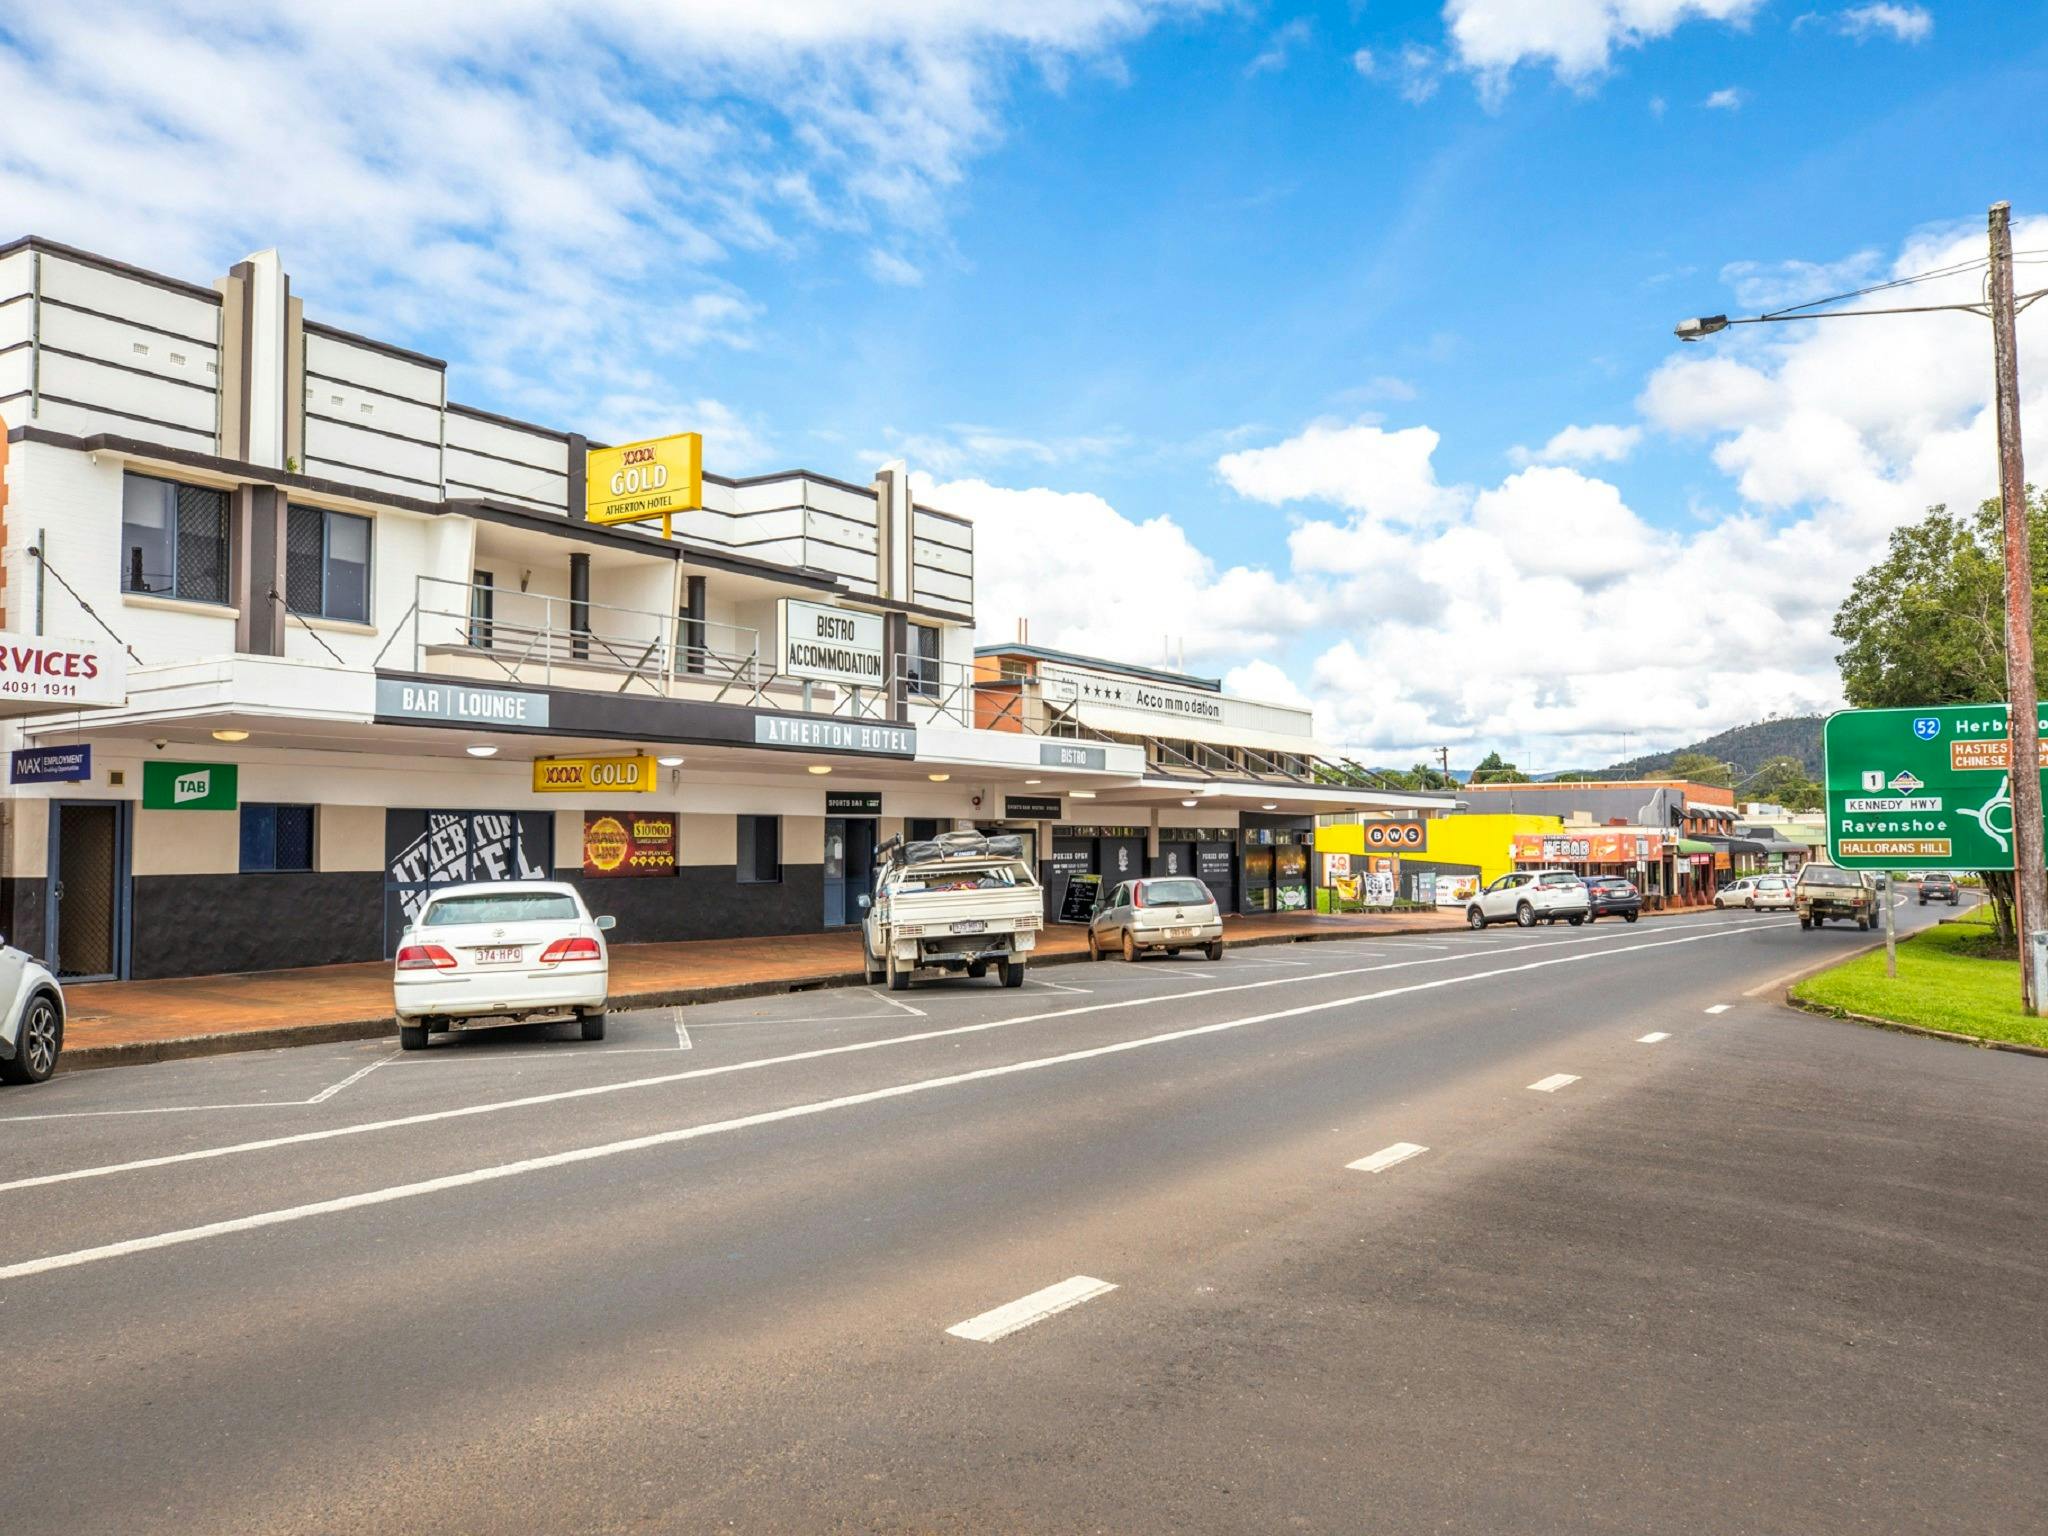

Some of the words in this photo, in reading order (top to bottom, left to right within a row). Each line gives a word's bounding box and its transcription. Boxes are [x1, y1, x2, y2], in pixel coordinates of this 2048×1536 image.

[624, 447, 654, 465] XXXX
[610, 464, 668, 496] GOLD
[606, 501, 646, 516] ATHERTON
[647, 495, 672, 509] HOTEL
[817, 615, 855, 641] BISTRO
[789, 643, 881, 676] ACCOMMODATION
[2, 681, 36, 694] 4091
[44, 683, 76, 697] 1911
[403, 687, 439, 712] BAR
[458, 692, 526, 719] LOUNGE
[1136, 689, 1220, 717] Accommodation
[768, 719, 853, 747] ATHERTON
[861, 727, 908, 751] HOTEL
[1917, 720, 1936, 735] 52
[1061, 748, 1088, 765] BISTRO
[1955, 743, 2008, 754] HASTIES
[16, 757, 42, 775] MAX
[43, 754, 84, 766] EMPLOYMENT
[1955, 755, 2006, 766] CHINESE
[546, 766, 583, 784] XXXX
[590, 763, 639, 785] GOLD
[1871, 774, 1877, 787] 1
[178, 780, 206, 793] TAB
[1849, 799, 1903, 810] KENNEDY
[1910, 799, 1937, 809] HWY
[1841, 818, 1949, 833] Ravenshoe
[1373, 830, 1417, 840] BWS
[1842, 842, 1916, 854] HALLORANS
[1920, 841, 1947, 853] HILL
